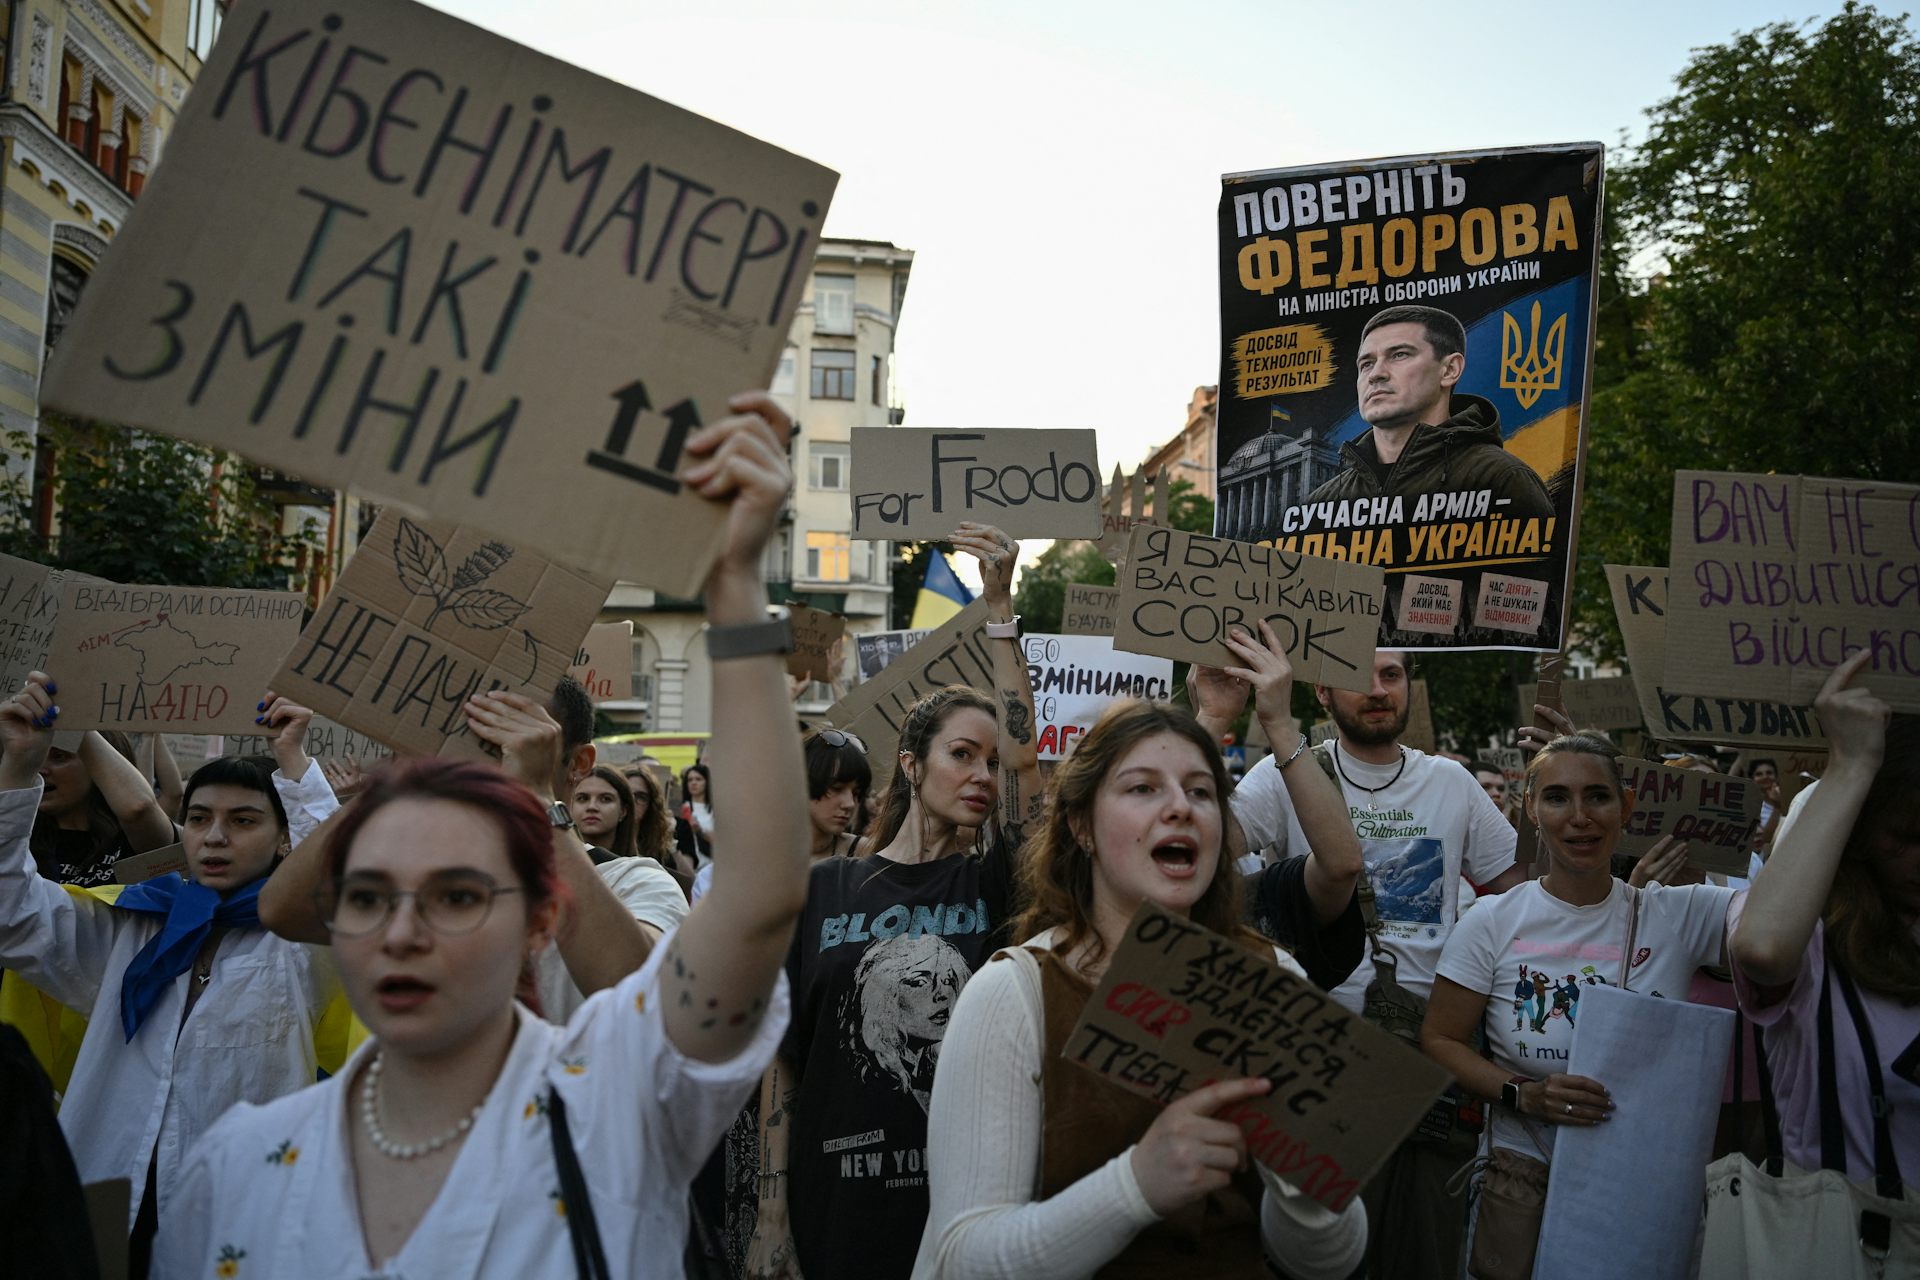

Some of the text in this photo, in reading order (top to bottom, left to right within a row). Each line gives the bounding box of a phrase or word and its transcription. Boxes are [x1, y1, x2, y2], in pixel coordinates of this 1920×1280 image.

[1233, 163, 1467, 238] ПОВЕРНІТЬ
[1237, 195, 1579, 296] ФЕДОРОВА
[287, 186, 541, 374] ТАКІ
[1278, 261, 1541, 316] НА МІНІСТРА ОБОРОНИ УКРАЇНИ
[1246, 331, 1299, 356] ДОСВІД
[1246, 349, 1322, 374] ТЕХНОЛОГІЇ
[102, 279, 521, 498] ЗМІНИ
[1246, 370, 1320, 392] РЕЗУЛЬТАТ
[1282, 495, 1404, 533] СУЧАСНА
[1412, 489, 1492, 522] АРМІЯ
[1692, 479, 1795, 551] ВАМ
[1826, 487, 1882, 557] НЕ
[1138, 530, 1302, 580] Я БАЧУ
[1257, 513, 1555, 566] ИЛЬНА УКРАЇНА!
[1135, 567, 1216, 597] ВАС
[1417, 582, 1450, 597] ДОСВІД,
[1489, 581, 1503, 592] ЧАС
[1505, 583, 1532, 596] ДІЯТИ
[75, 588, 304, 620] ВІДІБРАЛИ ОСТАННЮ
[1408, 611, 1452, 625] ЗНАЧЕННЯ!
[1411, 597, 1452, 610] ЯКИЙ МАЄ
[1484, 595, 1538, 611] А НЕ ШУКАТИ
[1485, 609, 1531, 624] ВІДМОВКИ!
[292, 597, 396, 698] НЕ
[1132, 600, 1358, 671] СОВОК
[99, 682, 229, 722] НАДІЮ
[1656, 686, 1826, 738] КАТУВАТ
[1700, 779, 1745, 810] НЕ
[1350, 807, 1414, 821] Essentials
[1357, 821, 1427, 838] Cultivation
[1136, 914, 1200, 954] ОТ
[1075, 1024, 1191, 1104] ТРЕБА
[857, 1131, 880, 1144] FROM
[841, 1152, 882, 1178] NEW
[886, 1177, 924, 1188] FEBRUARY
